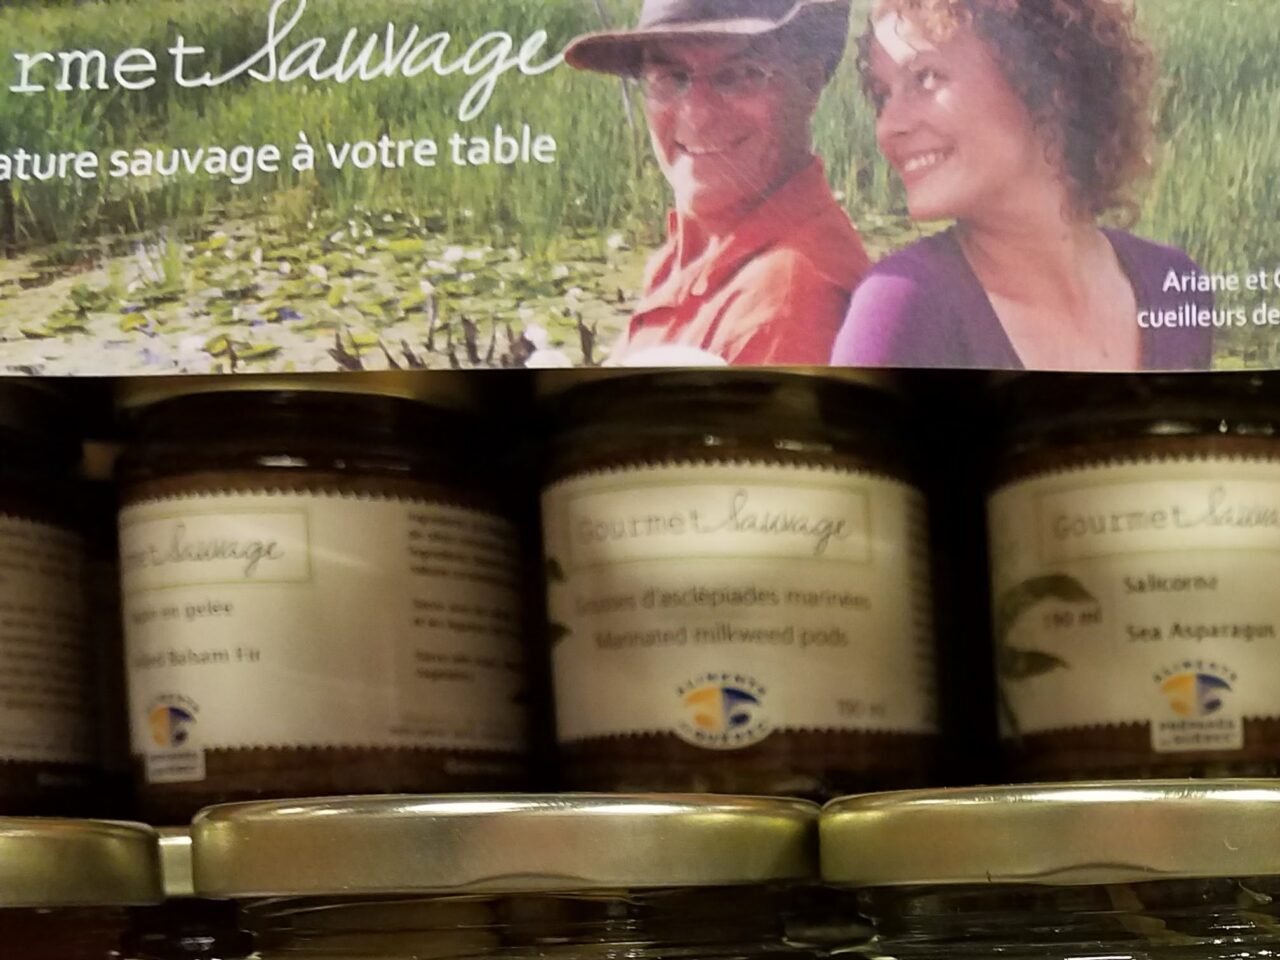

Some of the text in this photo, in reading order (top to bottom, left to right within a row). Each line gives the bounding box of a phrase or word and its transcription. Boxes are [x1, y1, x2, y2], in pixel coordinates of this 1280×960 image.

[205, 0, 567, 122] Sauvage
[109, 145, 281, 185] sauvage
[291, 131, 316, 172] à
[327, 138, 437, 171] votre
[448, 124, 558, 166] table
[1162, 270, 1239, 293] Ariane
[1245, 273, 1269, 291] et
[1137, 303, 1247, 329] cueilleurs
[1252, 304, 1280, 325] de
